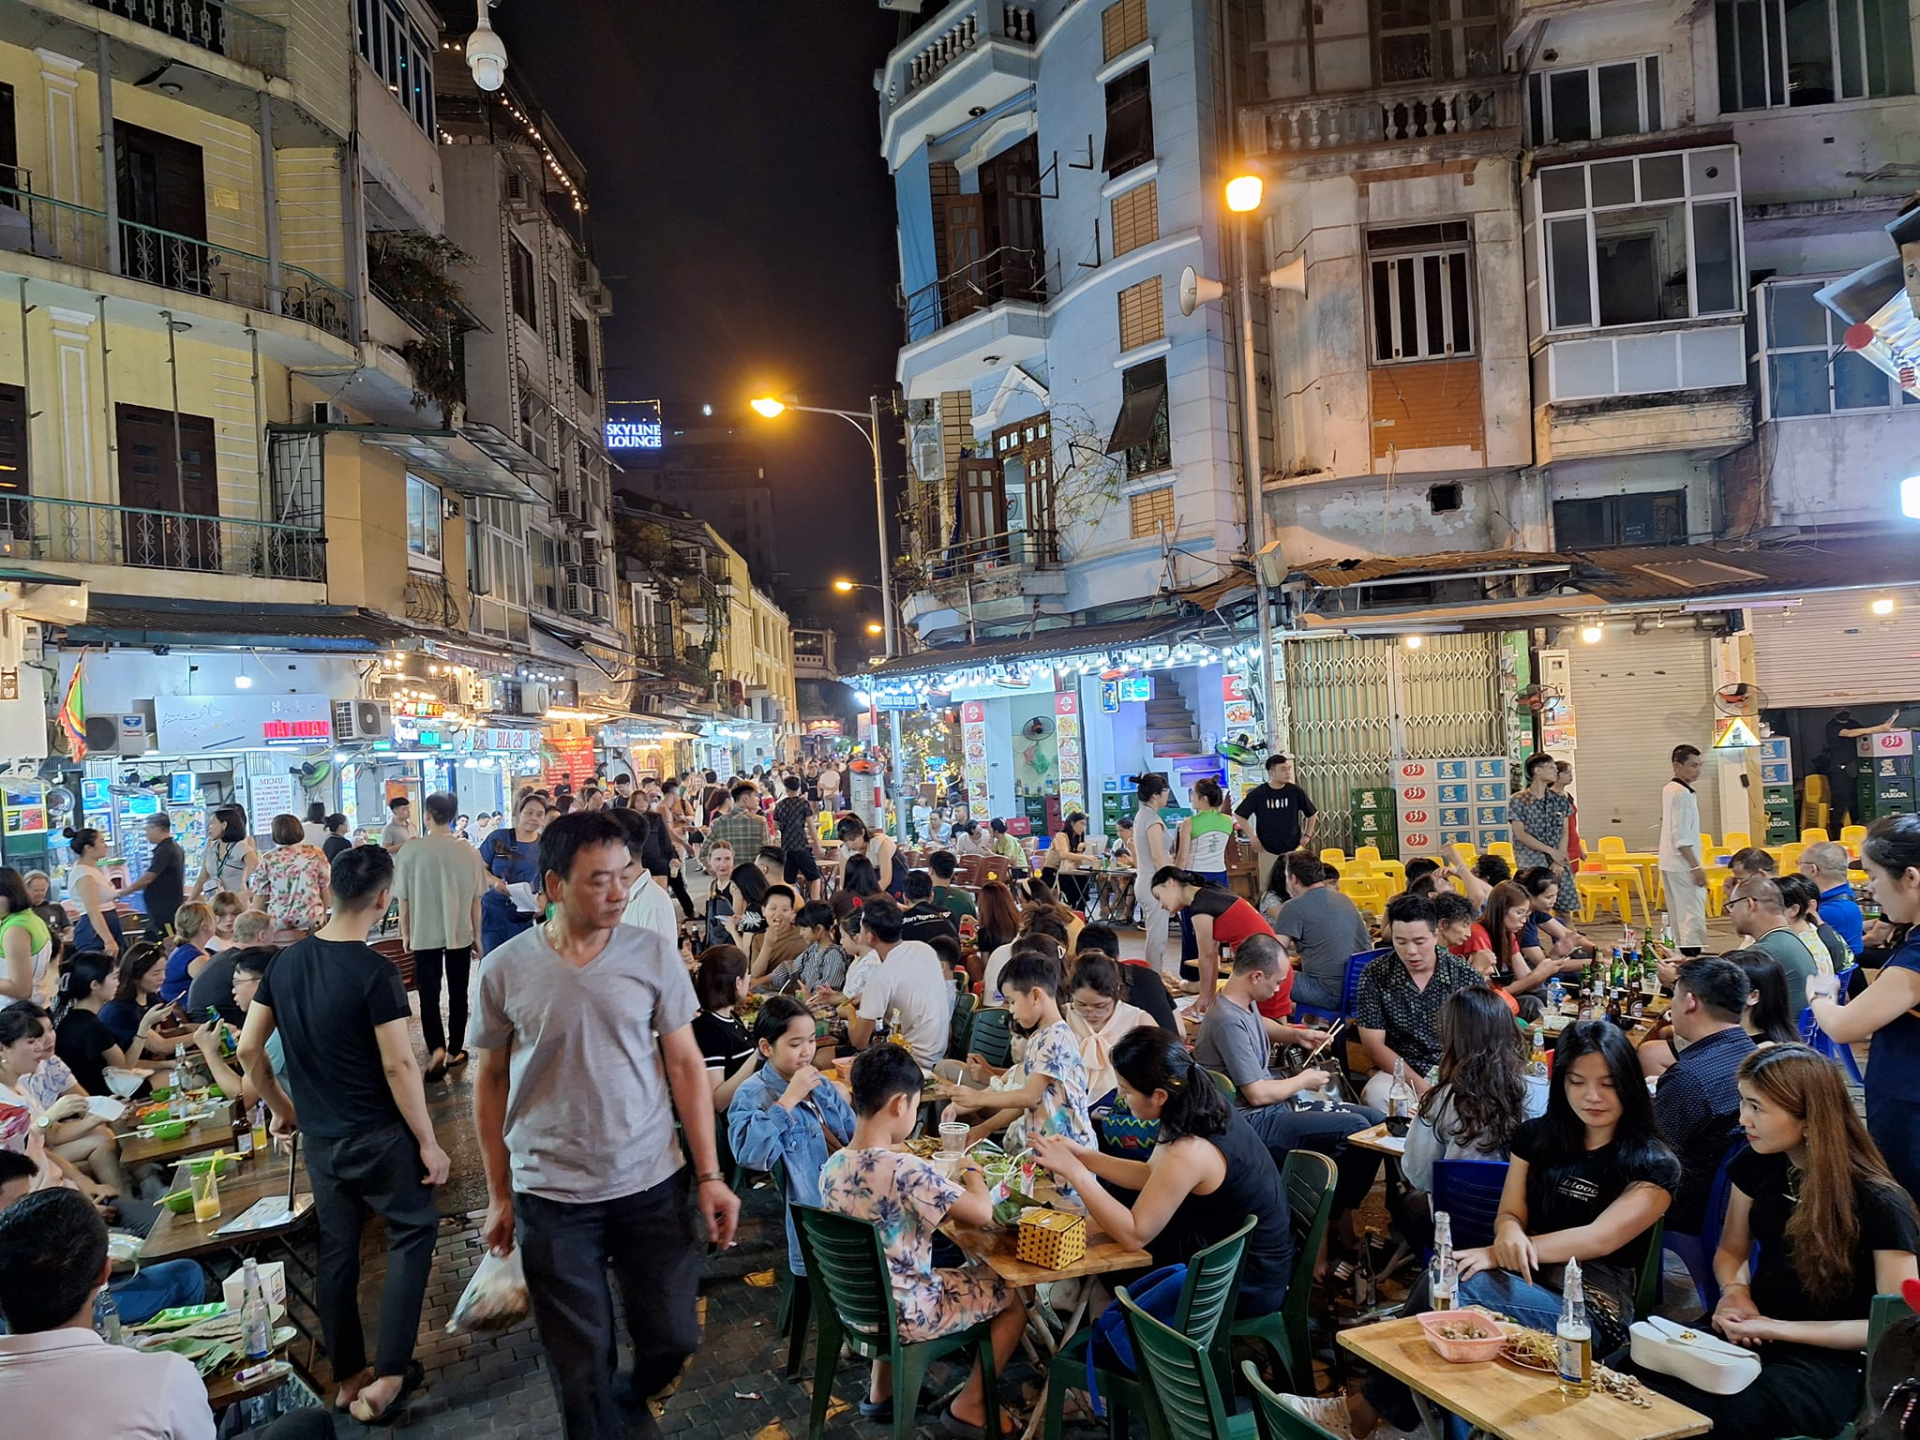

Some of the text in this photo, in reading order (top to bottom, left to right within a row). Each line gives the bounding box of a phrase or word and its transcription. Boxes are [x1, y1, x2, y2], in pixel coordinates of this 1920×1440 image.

[606, 423, 661, 436] SKYLINE
[608, 435, 662, 448] LOUNGE
[496, 731, 523, 748] BIA 29
[260, 777, 283, 785] MENU
[1880, 791, 1908, 799] SAIGON
[1768, 819, 1791, 827] AIGON
